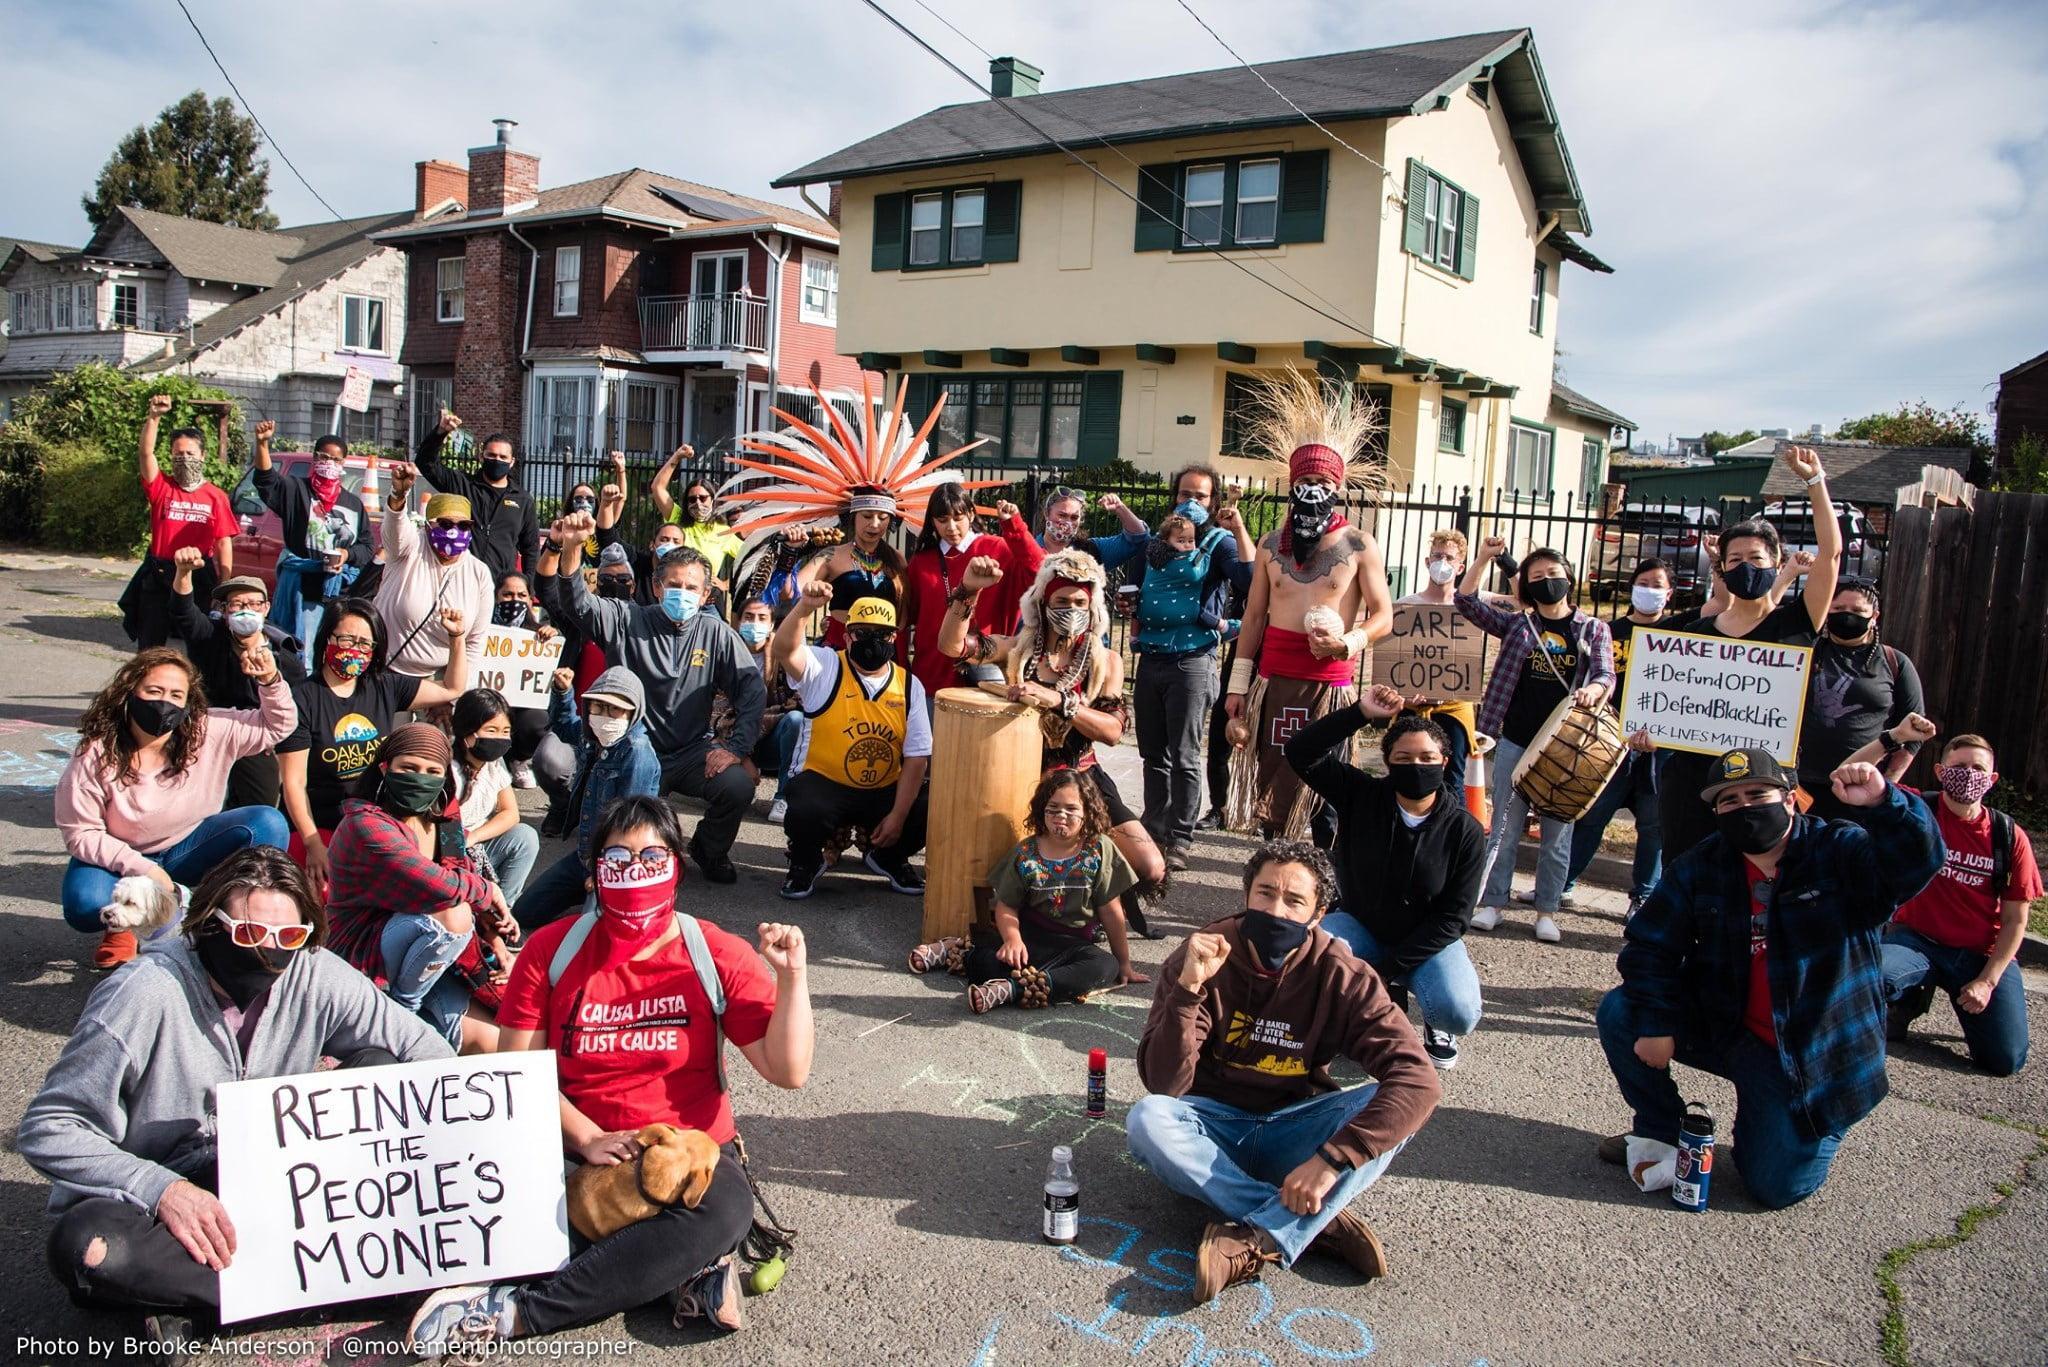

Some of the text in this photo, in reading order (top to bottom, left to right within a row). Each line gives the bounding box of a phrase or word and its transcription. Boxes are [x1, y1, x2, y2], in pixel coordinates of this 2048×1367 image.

[857, 605, 892, 622] TOWN
[1392, 610, 1468, 640] CARE
[483, 636, 513, 657] NO
[1413, 644, 1449, 660] NOT
[1646, 634, 1714, 659] WAKE
[1719, 644, 1746, 662] UP
[478, 670, 505, 691] NO
[1390, 661, 1470, 691] COPS!
[843, 722, 898, 743] TOWN
[1625, 720, 1668, 737] BLACK
[1670, 727, 1708, 742] LIVES
[860, 769, 877, 783] 30
[1963, 853, 1995, 870] JUSTA
[581, 994, 687, 1024] CAUSA JUSTA
[1255, 1026, 1284, 1038] CNTER
[1265, 1020, 1291, 1031] BAKER
[577, 1030, 679, 1054] JUST CAUSE
[272, 1070, 523, 1149] REINVEST
[360, 1135, 429, 1167] THE
[286, 1153, 504, 1230] PEOPLE'S
[293, 1215, 503, 1292] MONEY
